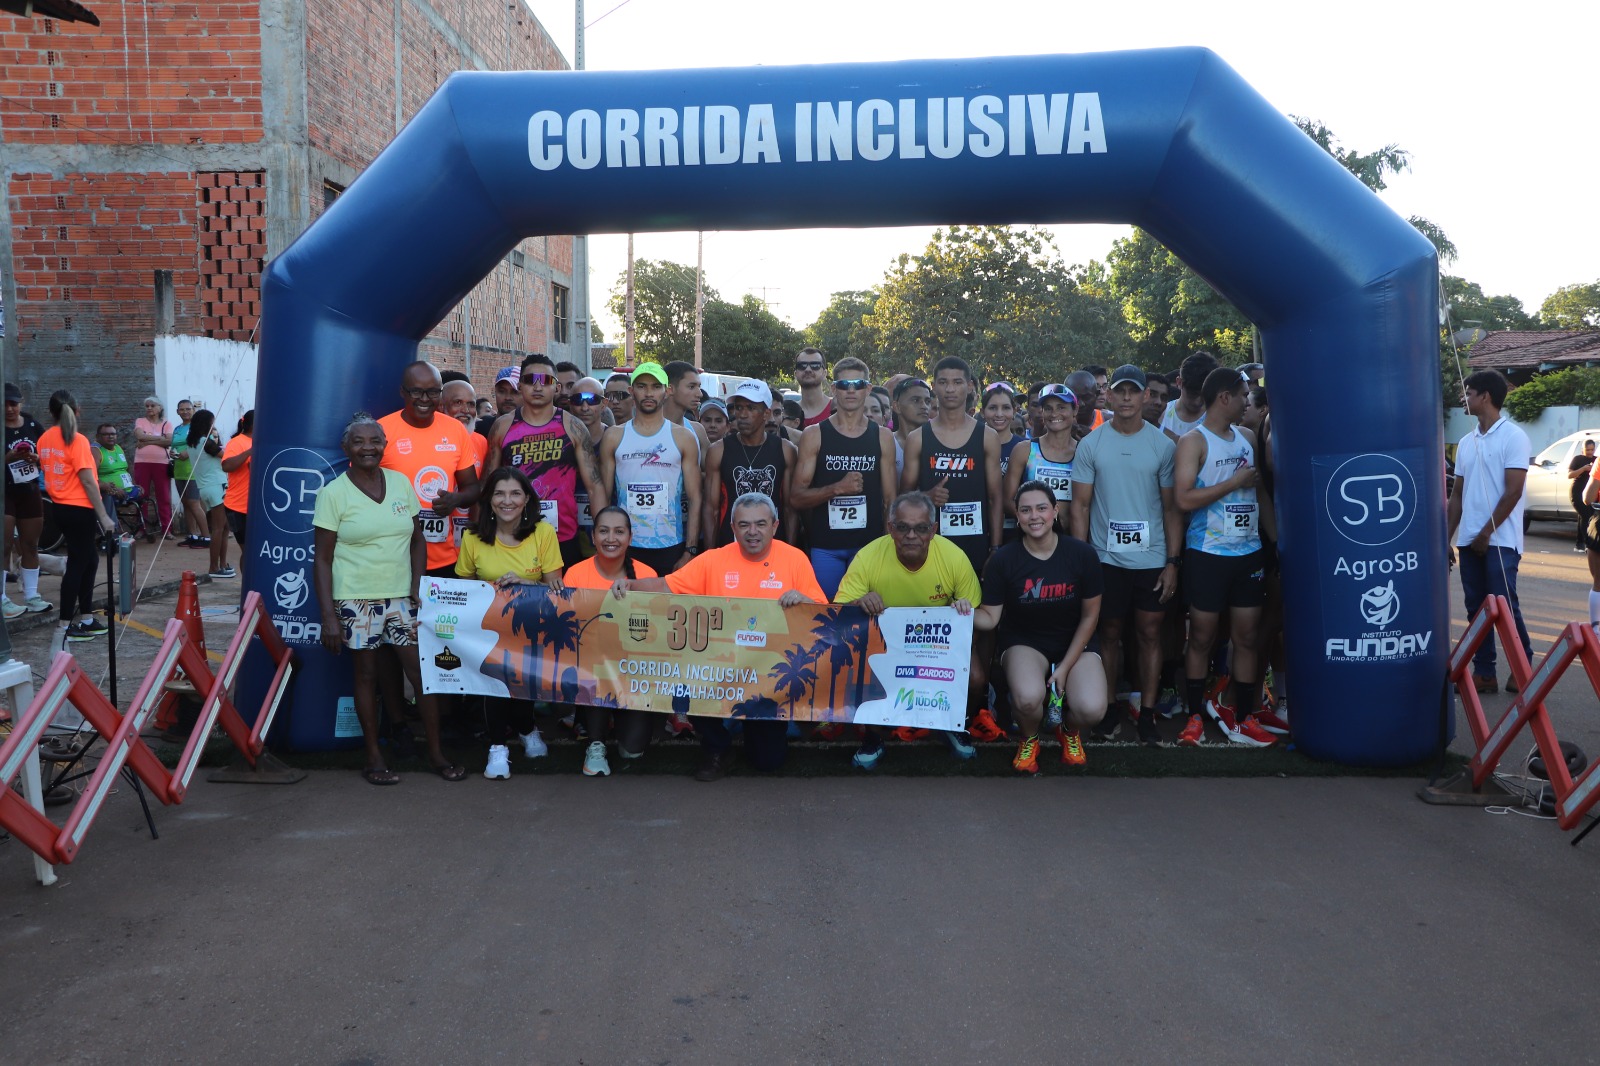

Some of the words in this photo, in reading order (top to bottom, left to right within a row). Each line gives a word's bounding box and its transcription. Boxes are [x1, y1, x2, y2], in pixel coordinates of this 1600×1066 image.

[527, 103, 782, 171] CORRIDA
[795, 92, 1108, 162] INCLUSIVA
[523, 432, 556, 442] EQUIPE
[511, 439, 564, 455] TREINO
[512, 454, 523, 465] &
[524, 449, 562, 465] FOCO
[850, 454, 867, 462] será
[19, 464, 35, 477] 156
[825, 460, 875, 471] CORRIDA
[635, 493, 655, 506] 33
[1340, 473, 1405, 526] SB
[839, 506, 857, 520] 72
[949, 513, 974, 527] 215
[1234, 513, 1250, 527] 22
[1115, 531, 1142, 545] 154
[259, 540, 315, 564] AgroS
[1333, 551, 1419, 581] AgroSB
[272, 614, 308, 622] INSTITUTO
[435, 613, 458, 625] JOÃO
[434, 624, 455, 633] LEITE
[667, 604, 723, 652] 30ª
[905, 623, 952, 636] PORTO
[1361, 629, 1402, 639] INSTITUTO
[737, 633, 765, 643] FUNDAV
[904, 635, 950, 644] NACIONAL
[1325, 630, 1433, 657] FUNDAV
[618, 659, 681, 678] CORRIDA
[686, 664, 758, 684] INCLUSIVA
[896, 667, 915, 676] DIVA
[918, 668, 954, 679] CARDOSO
[630, 679, 650, 694] DO
[654, 681, 744, 701] TRABALHADOR
